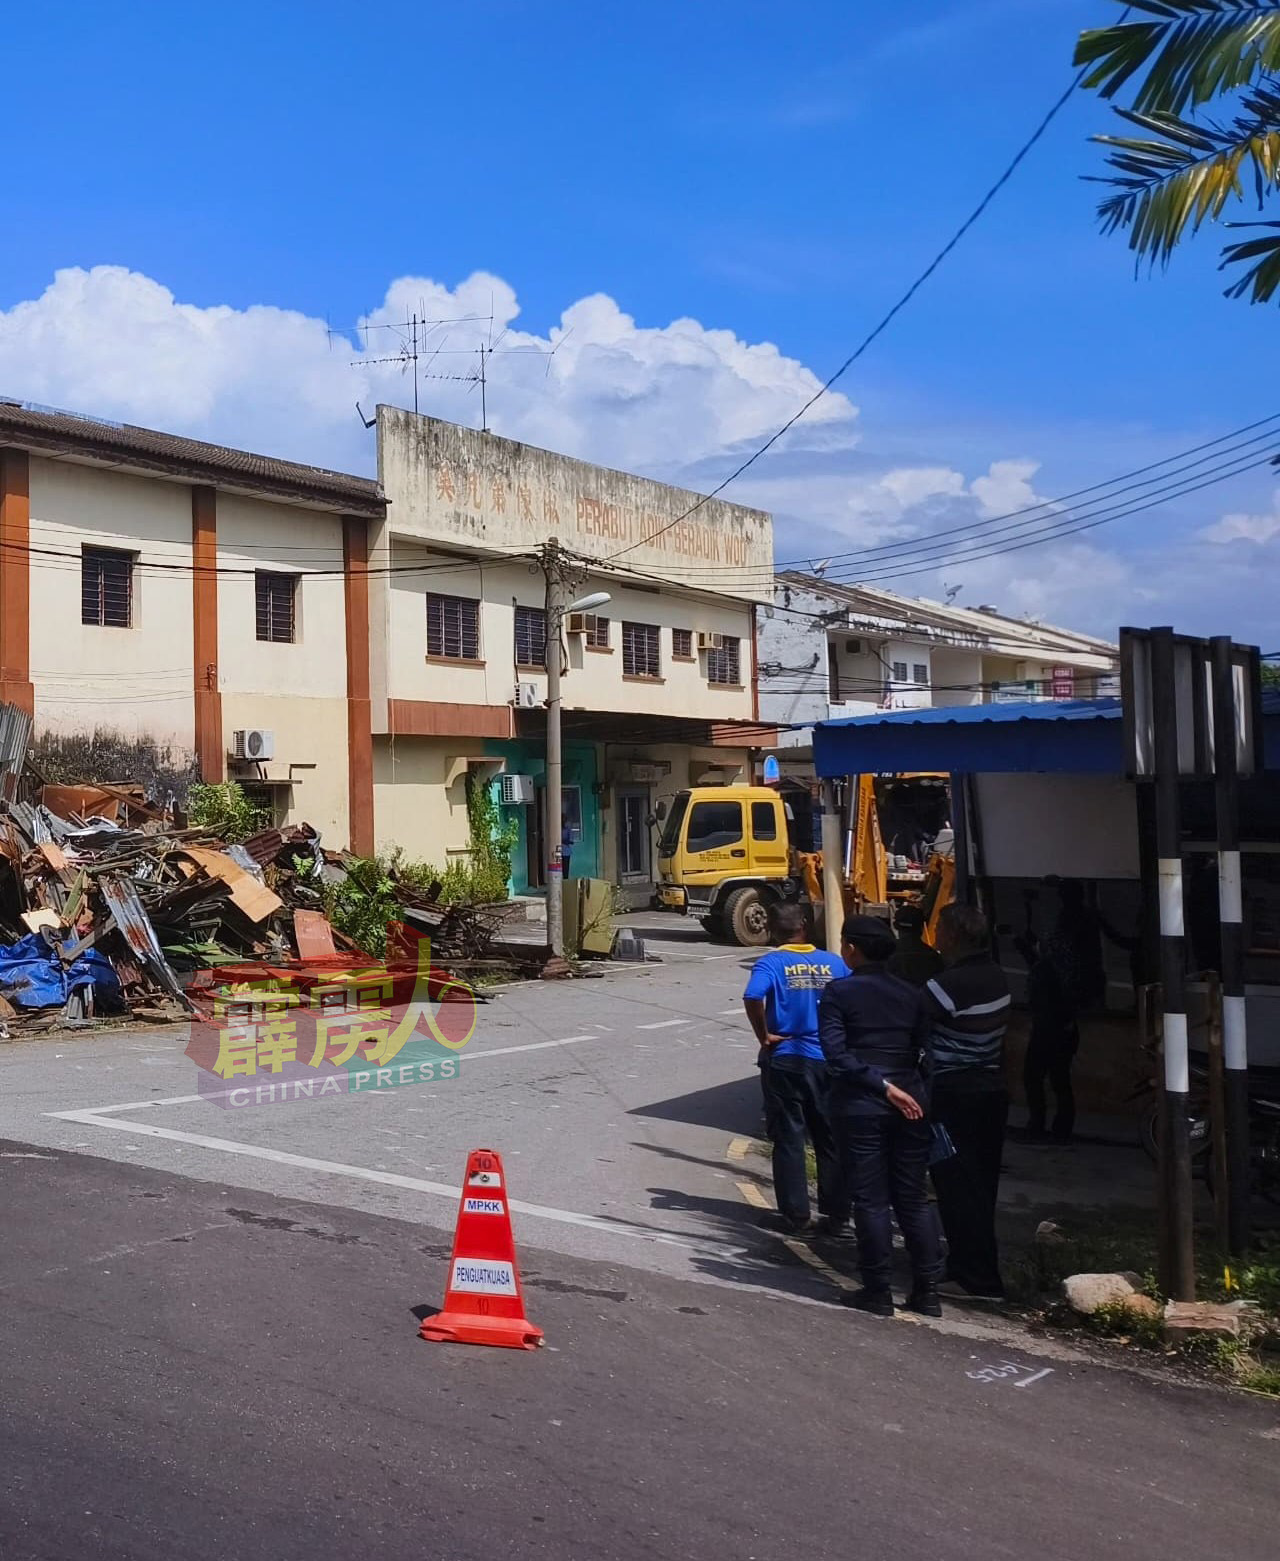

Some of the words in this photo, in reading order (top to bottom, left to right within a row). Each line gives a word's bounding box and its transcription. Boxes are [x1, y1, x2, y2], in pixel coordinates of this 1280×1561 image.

[576, 497, 634, 543] PERABUT
[475, 1158, 492, 1170] 10
[467, 1200, 500, 1212] MPKK
[456, 1266, 510, 1286] PENGUATKUASA
[476, 1299, 489, 1315] 10
